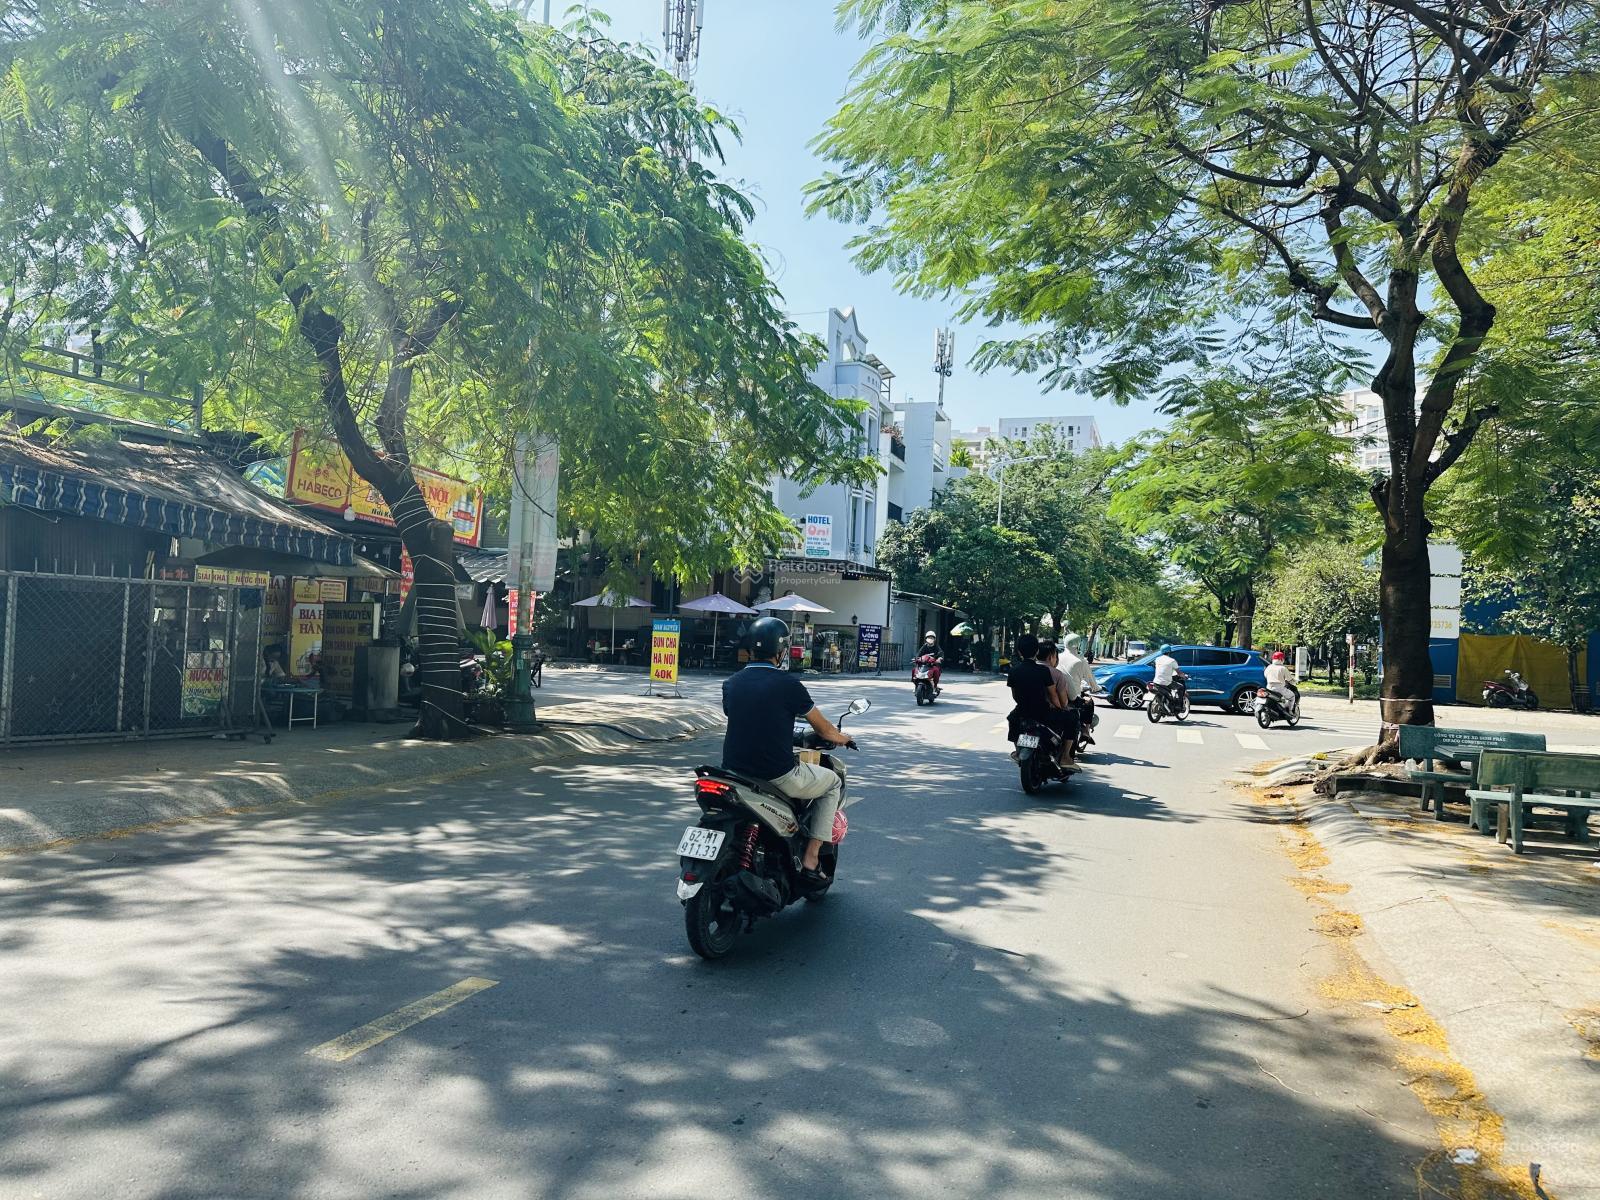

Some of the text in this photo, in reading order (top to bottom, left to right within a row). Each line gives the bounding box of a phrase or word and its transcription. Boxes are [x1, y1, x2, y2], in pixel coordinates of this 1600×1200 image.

[297, 479, 342, 498] HABECO
[807, 515, 831, 525] HOTEL
[299, 608, 316, 620] BIA
[299, 621, 315, 634] HÀ
[654, 669, 672, 680] 40K
[681, 841, 717, 858] 911.33
